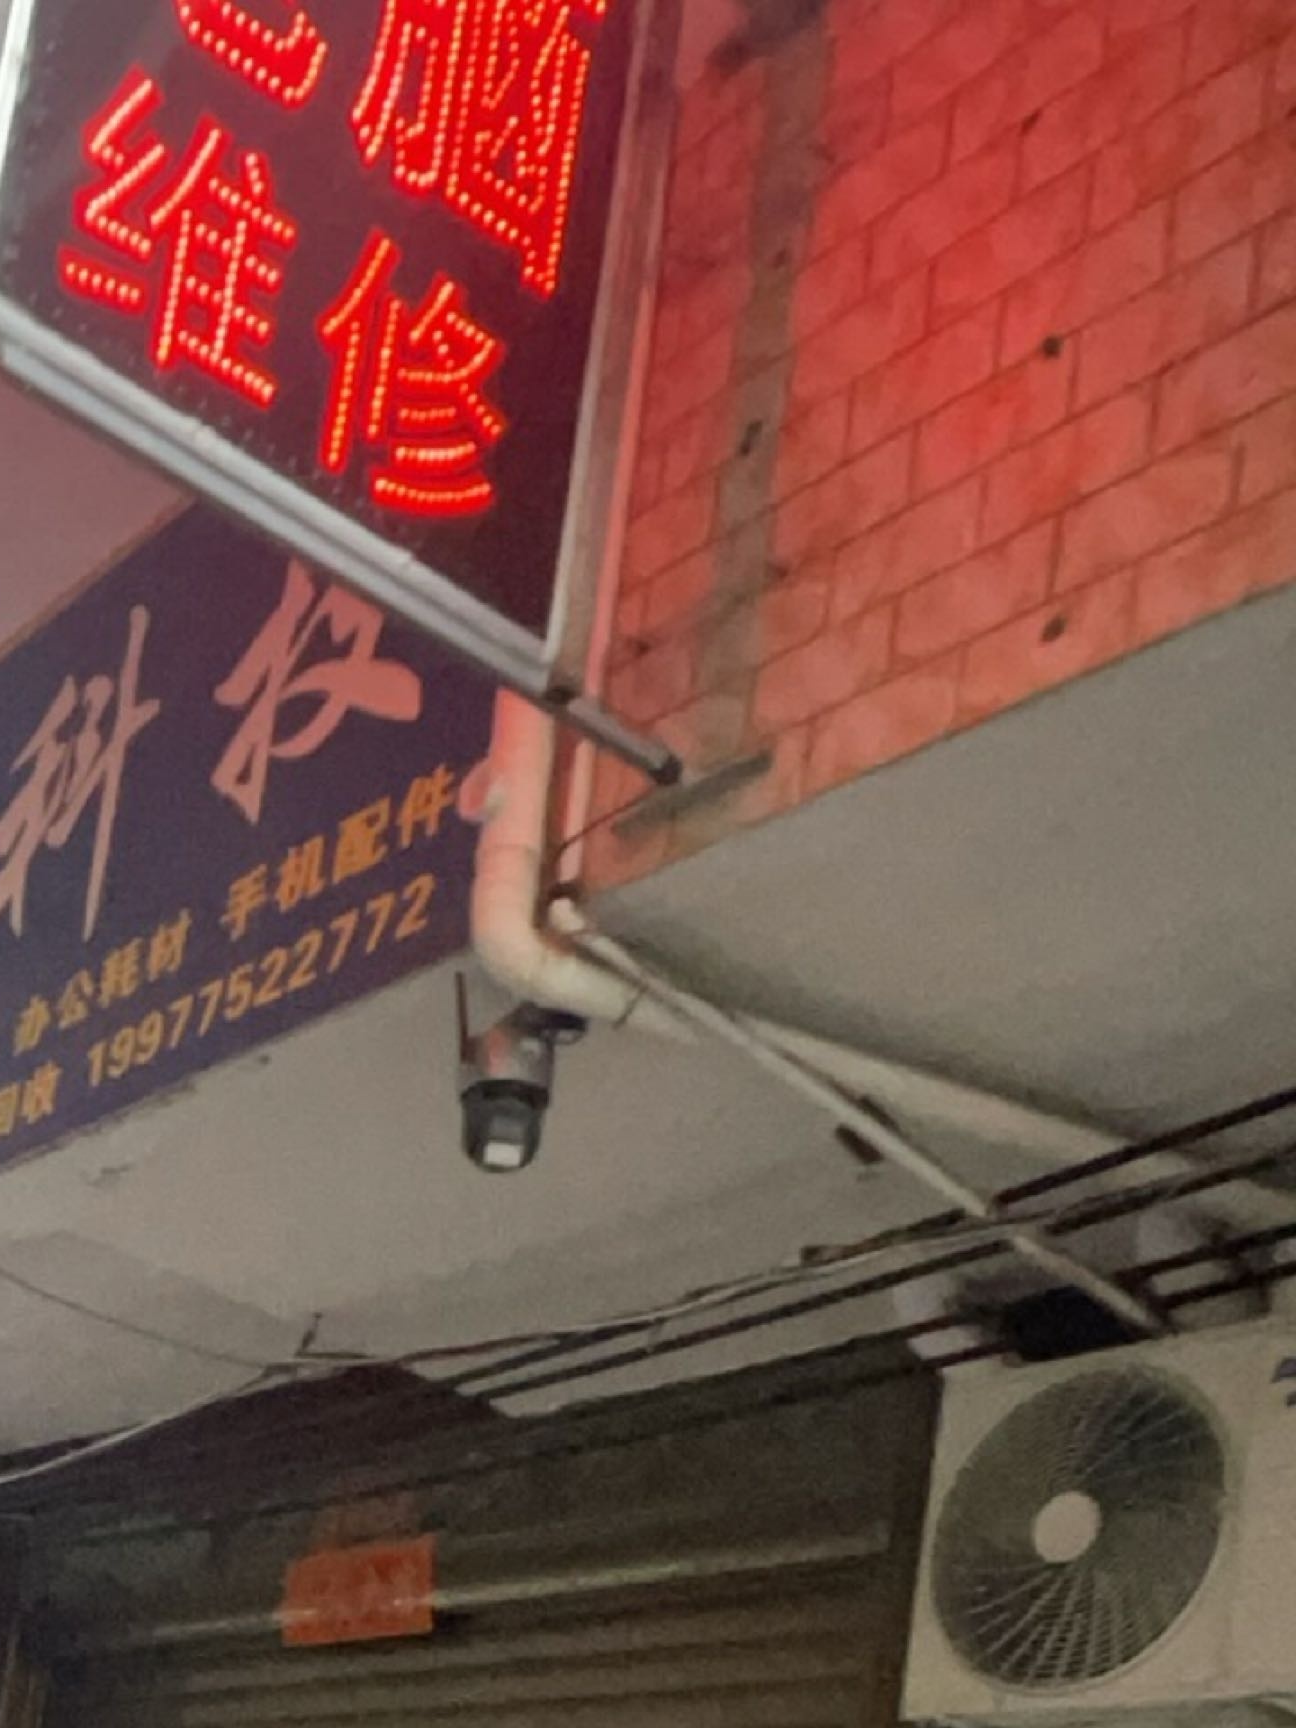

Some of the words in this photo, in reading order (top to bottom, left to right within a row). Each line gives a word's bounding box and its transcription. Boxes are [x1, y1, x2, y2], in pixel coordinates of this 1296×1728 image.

[57, 62, 506, 516] 维修
[13, 908, 192, 1056] 办公耗材
[219, 764, 455, 943] 手机配件
[87, 872, 437, 1087] 19977522772
